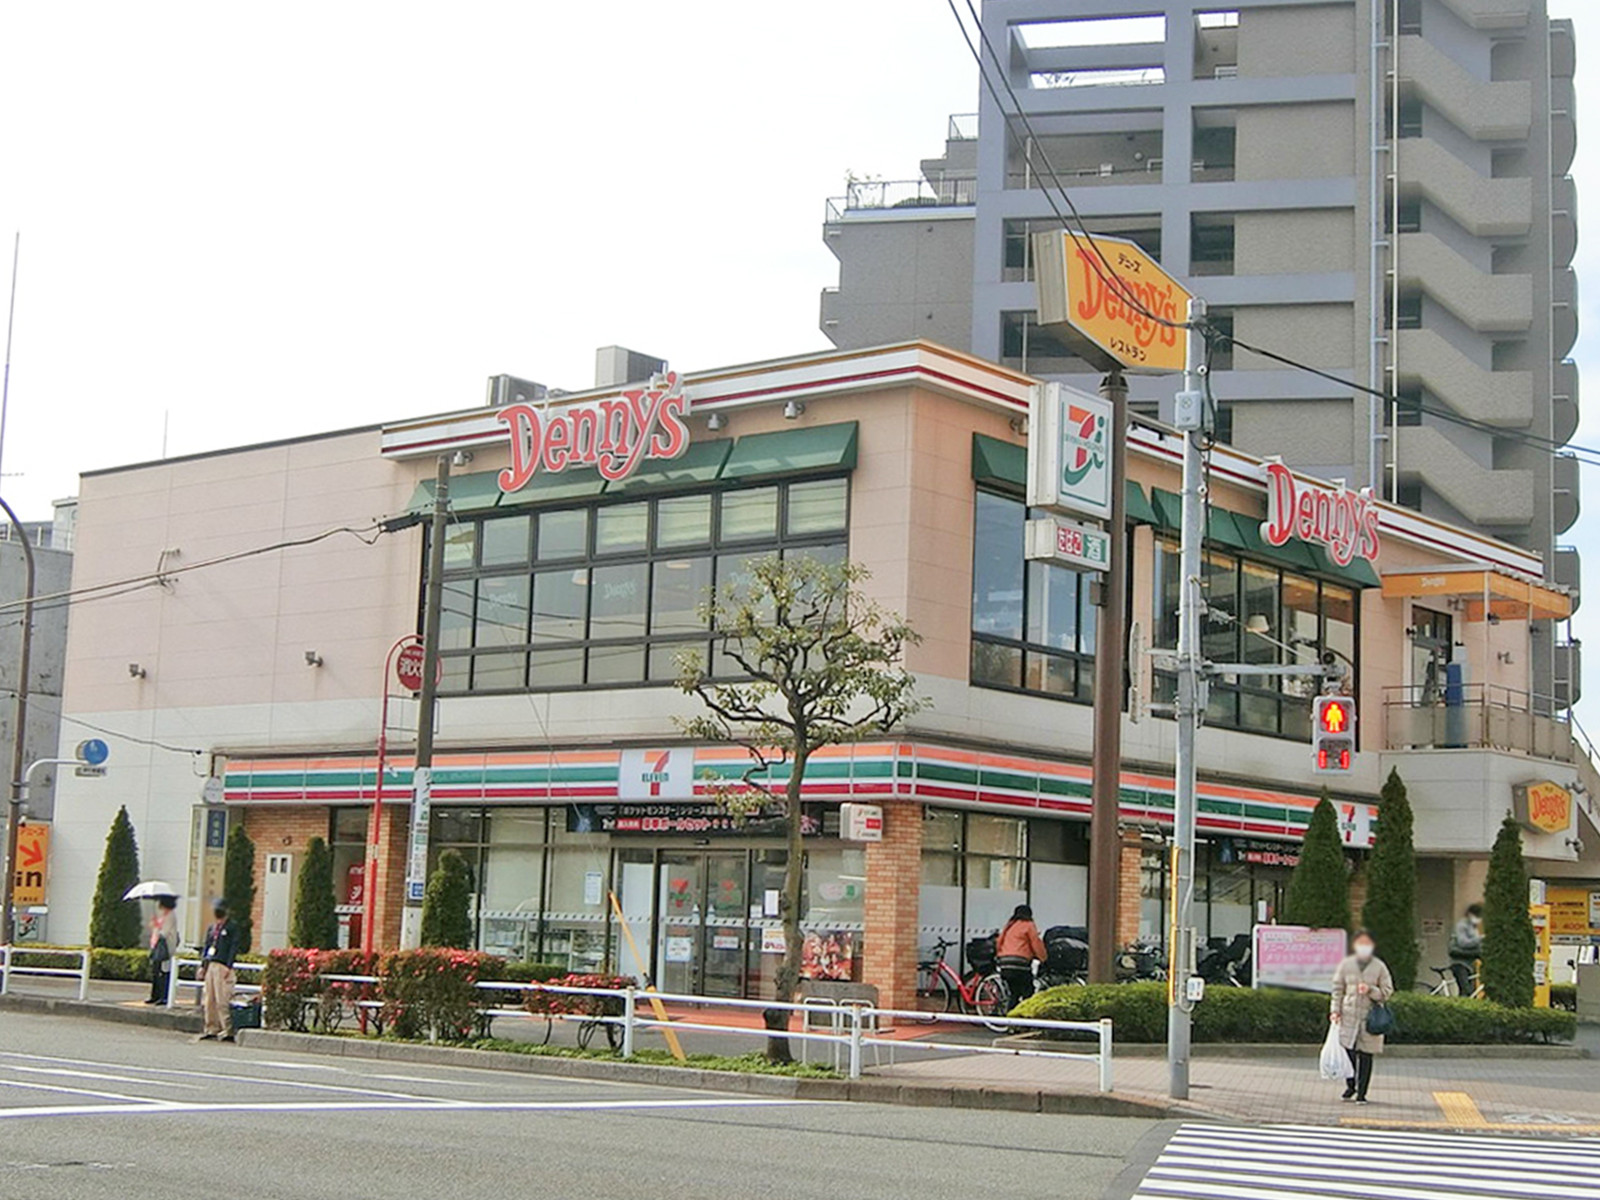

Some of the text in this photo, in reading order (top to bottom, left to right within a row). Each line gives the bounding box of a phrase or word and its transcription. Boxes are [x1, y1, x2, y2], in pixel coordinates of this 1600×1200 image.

[1076, 249, 1177, 348] Denny's
[1110, 337, 1147, 362] レストラン
[497, 370, 690, 493] Denny's
[1264, 463, 1379, 566] Denny's
[1058, 528, 1102, 561] たばこ 酒
[400, 657, 424, 677] 消火
[15, 870, 43, 888] in
